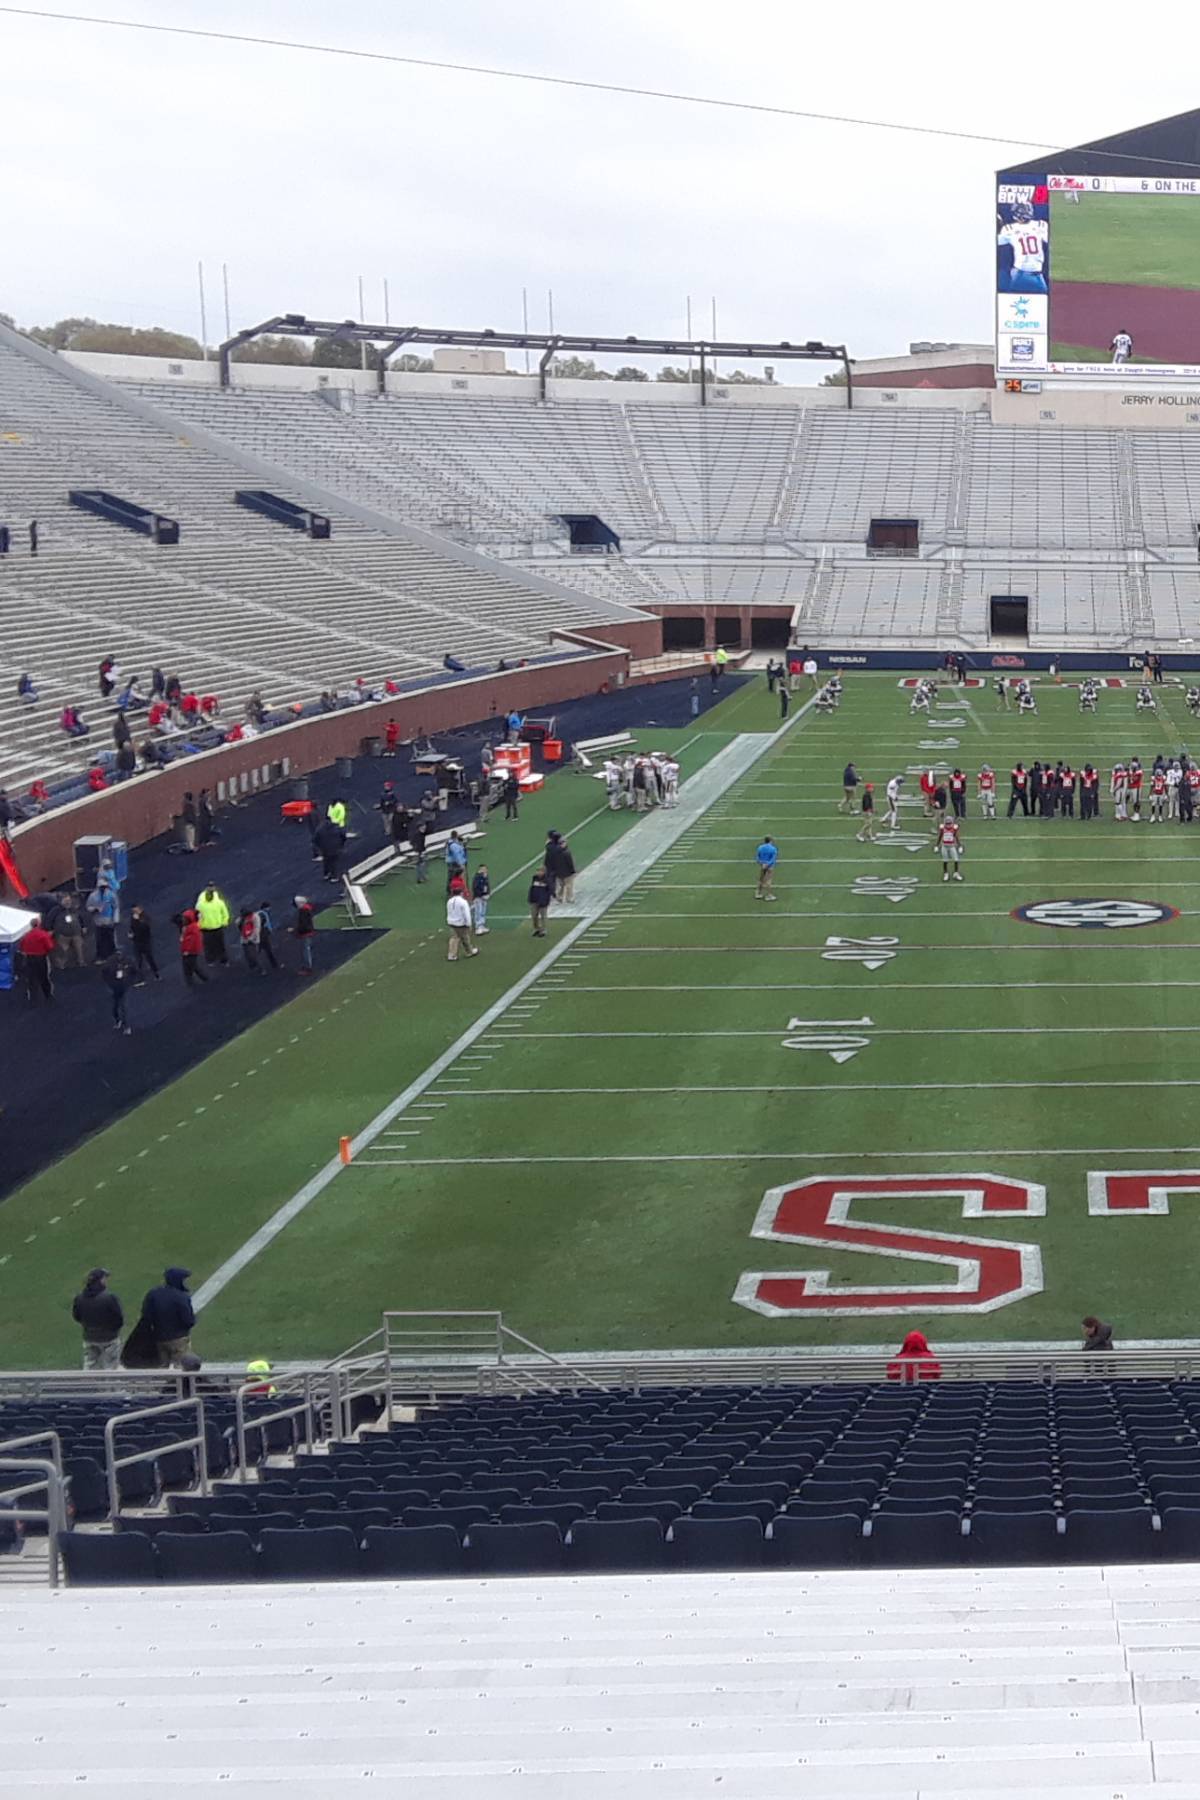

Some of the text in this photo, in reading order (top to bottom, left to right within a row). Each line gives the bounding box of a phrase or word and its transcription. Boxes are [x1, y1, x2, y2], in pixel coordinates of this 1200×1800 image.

[1155, 180, 1172, 191] ON
[1176, 181, 1197, 192] THE
[1018, 236, 1039, 255] 10
[1121, 395, 1155, 405] JERRY
[829, 656, 867, 664] NISSAN
[820, 935, 900, 961] 20
[780, 1015, 875, 1050] 10
